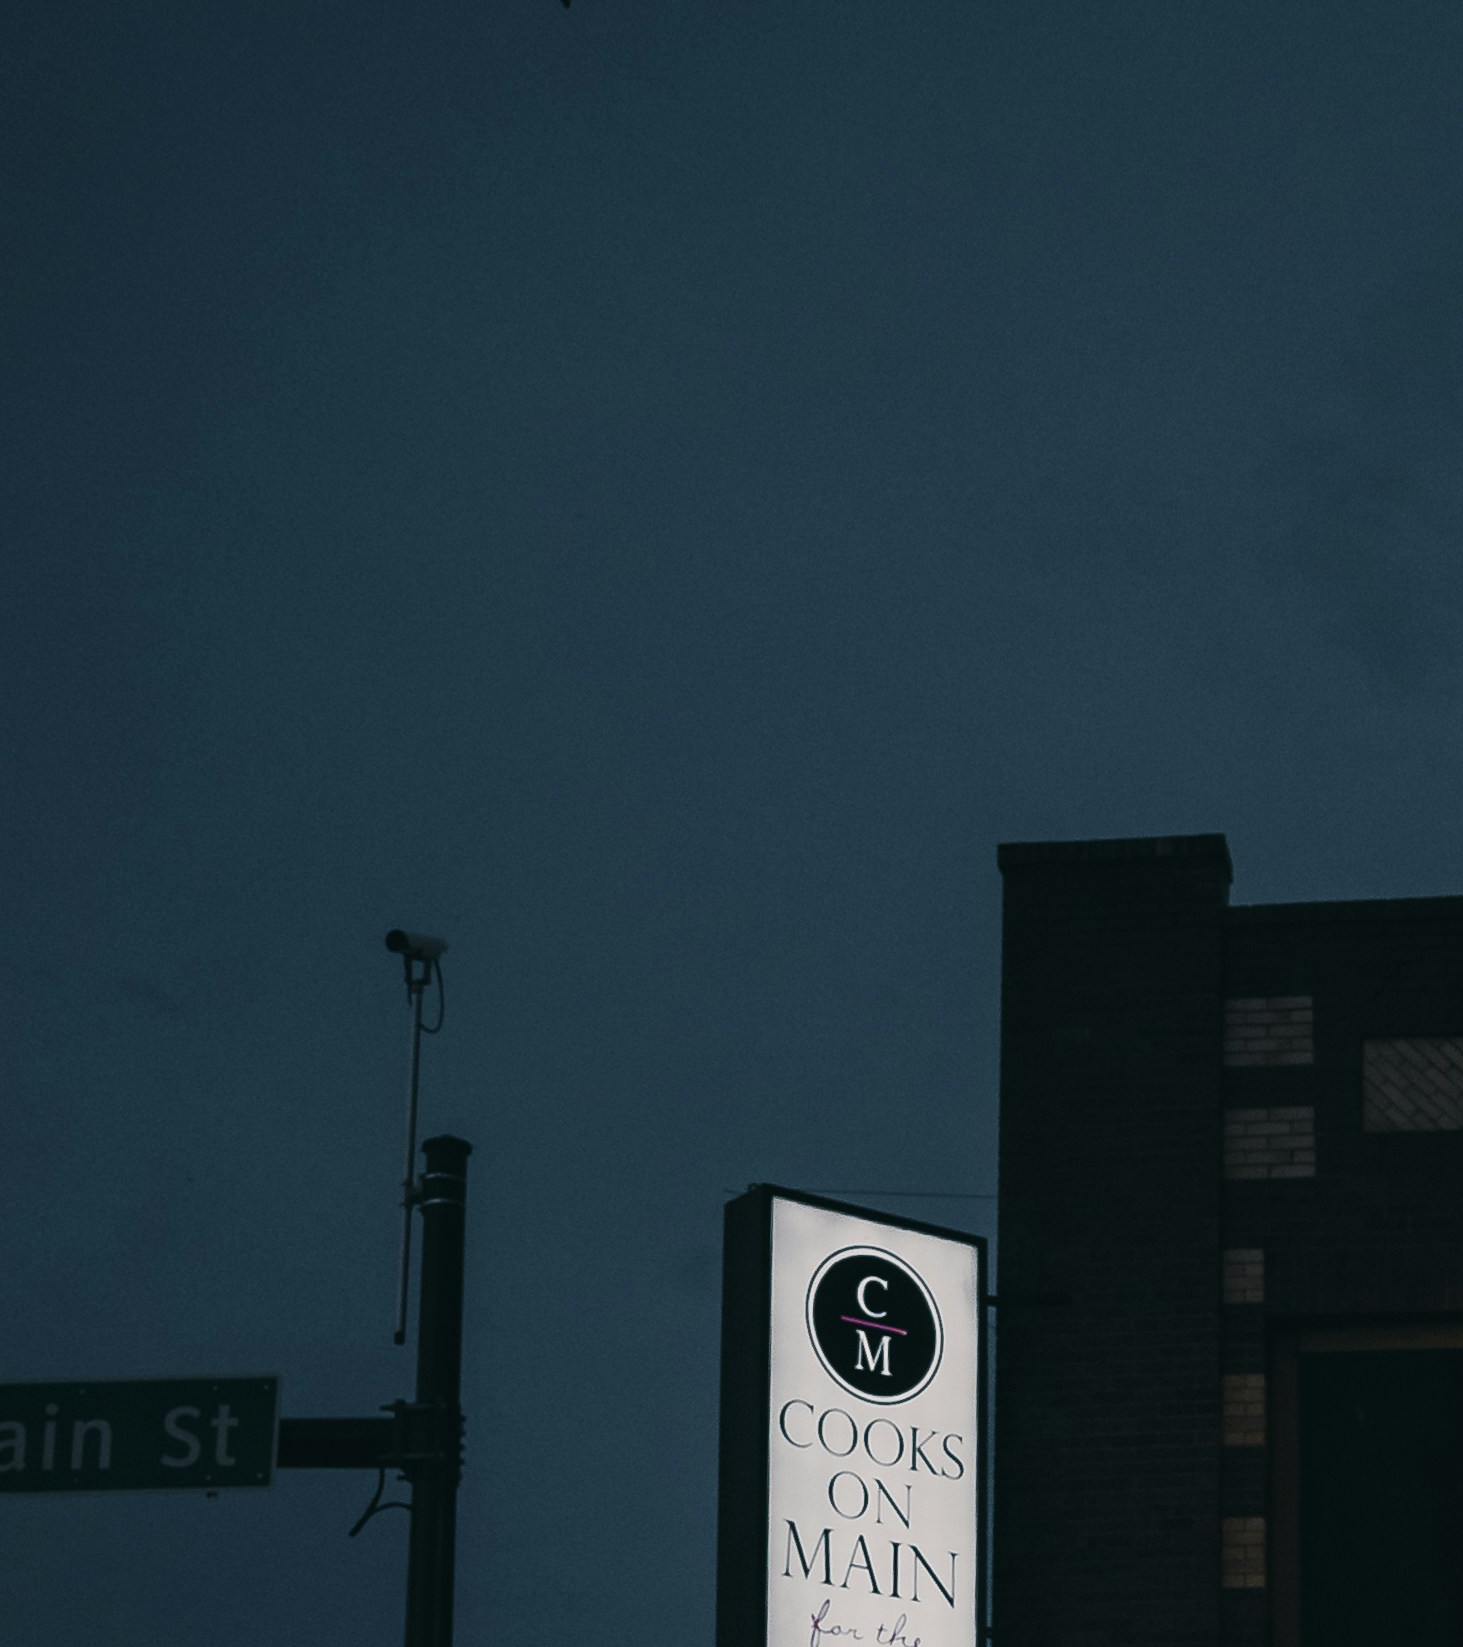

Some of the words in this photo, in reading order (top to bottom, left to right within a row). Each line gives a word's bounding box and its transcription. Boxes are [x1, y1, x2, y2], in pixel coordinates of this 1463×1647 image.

[856, 1275, 889, 1319] C
[853, 1329, 894, 1377] M
[159, 1403, 240, 1468] St
[779, 1398, 965, 1480] COOKS
[828, 1470, 912, 1529] ON
[782, 1518, 959, 1609] MAIN
